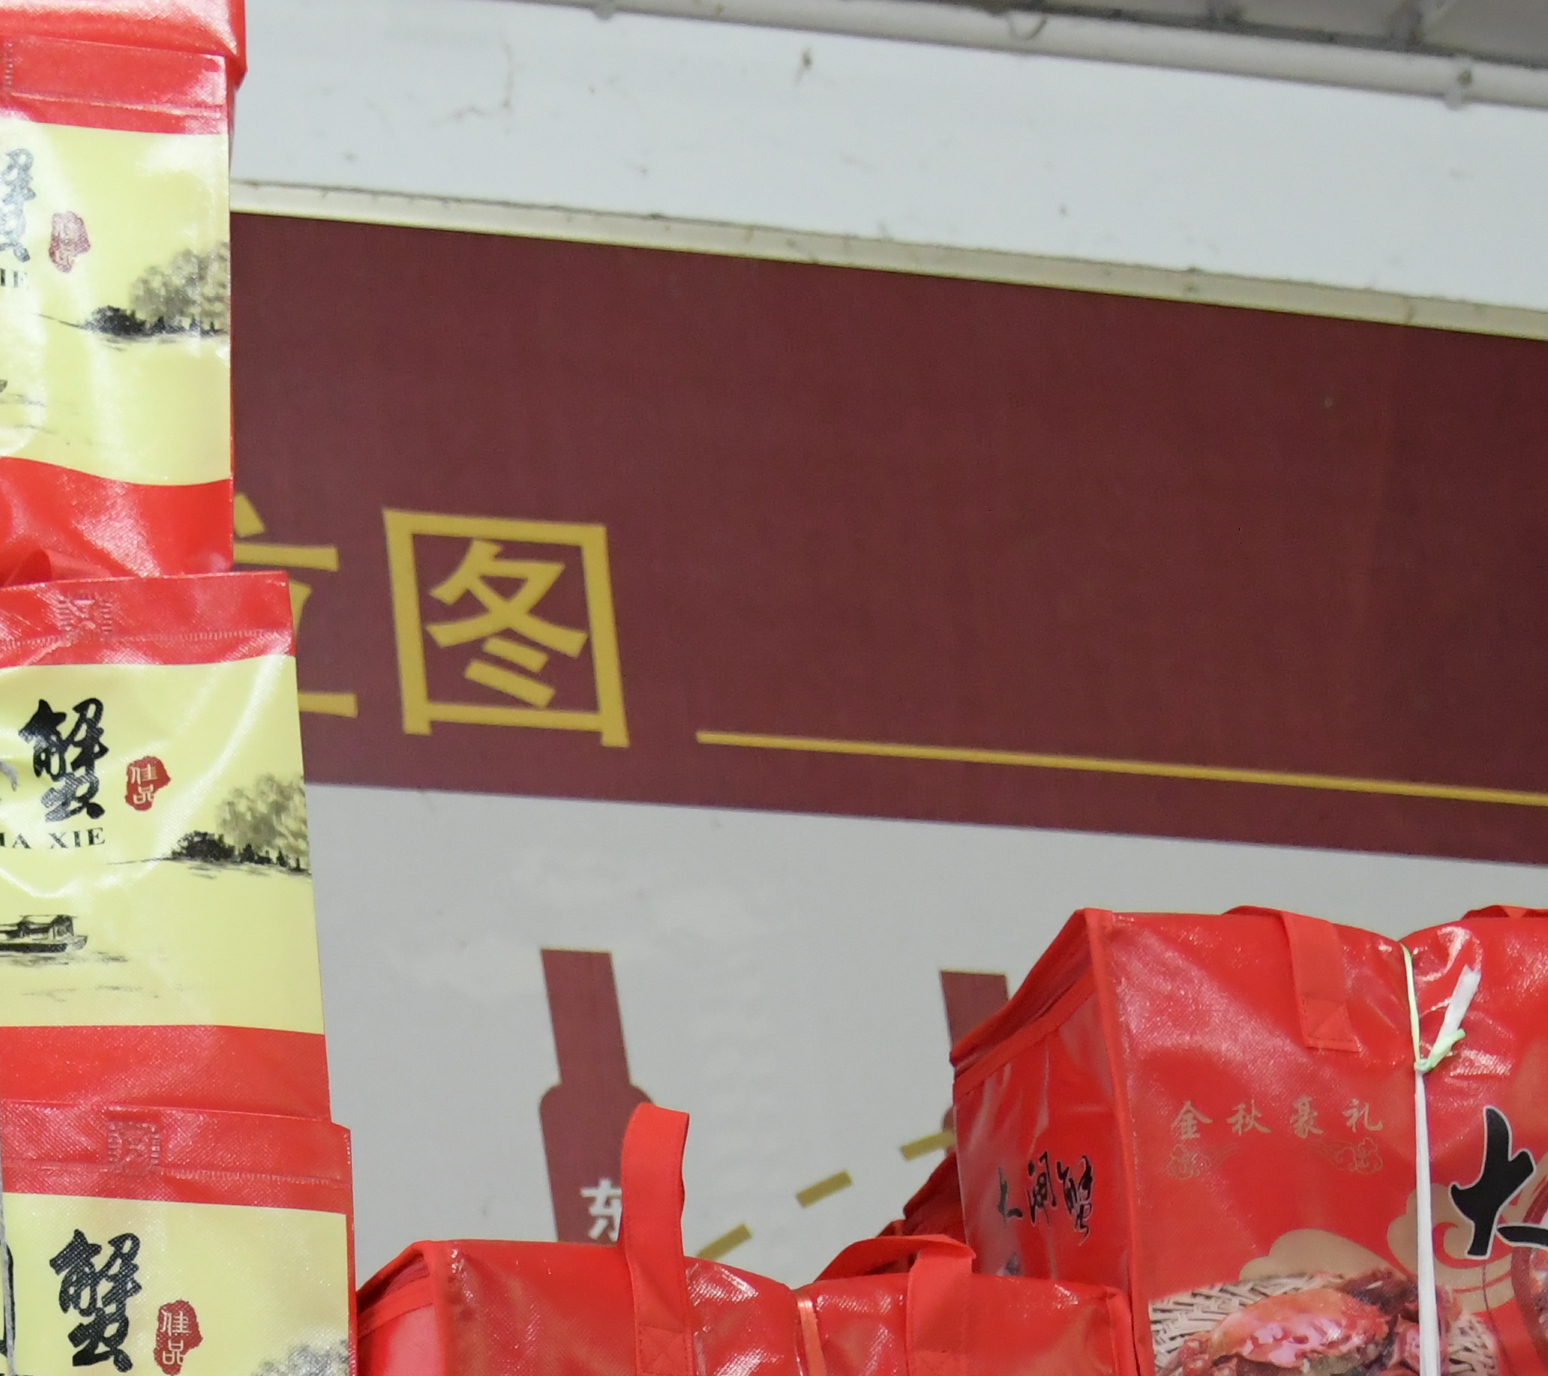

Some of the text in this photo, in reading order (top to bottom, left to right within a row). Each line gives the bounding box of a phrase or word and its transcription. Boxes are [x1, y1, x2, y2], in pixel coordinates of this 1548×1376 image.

[48, 825, 106, 848] XIE
[1170, 1096, 1384, 1135] 金秋豪礼
[161, 1308, 194, 1367] 佳品
